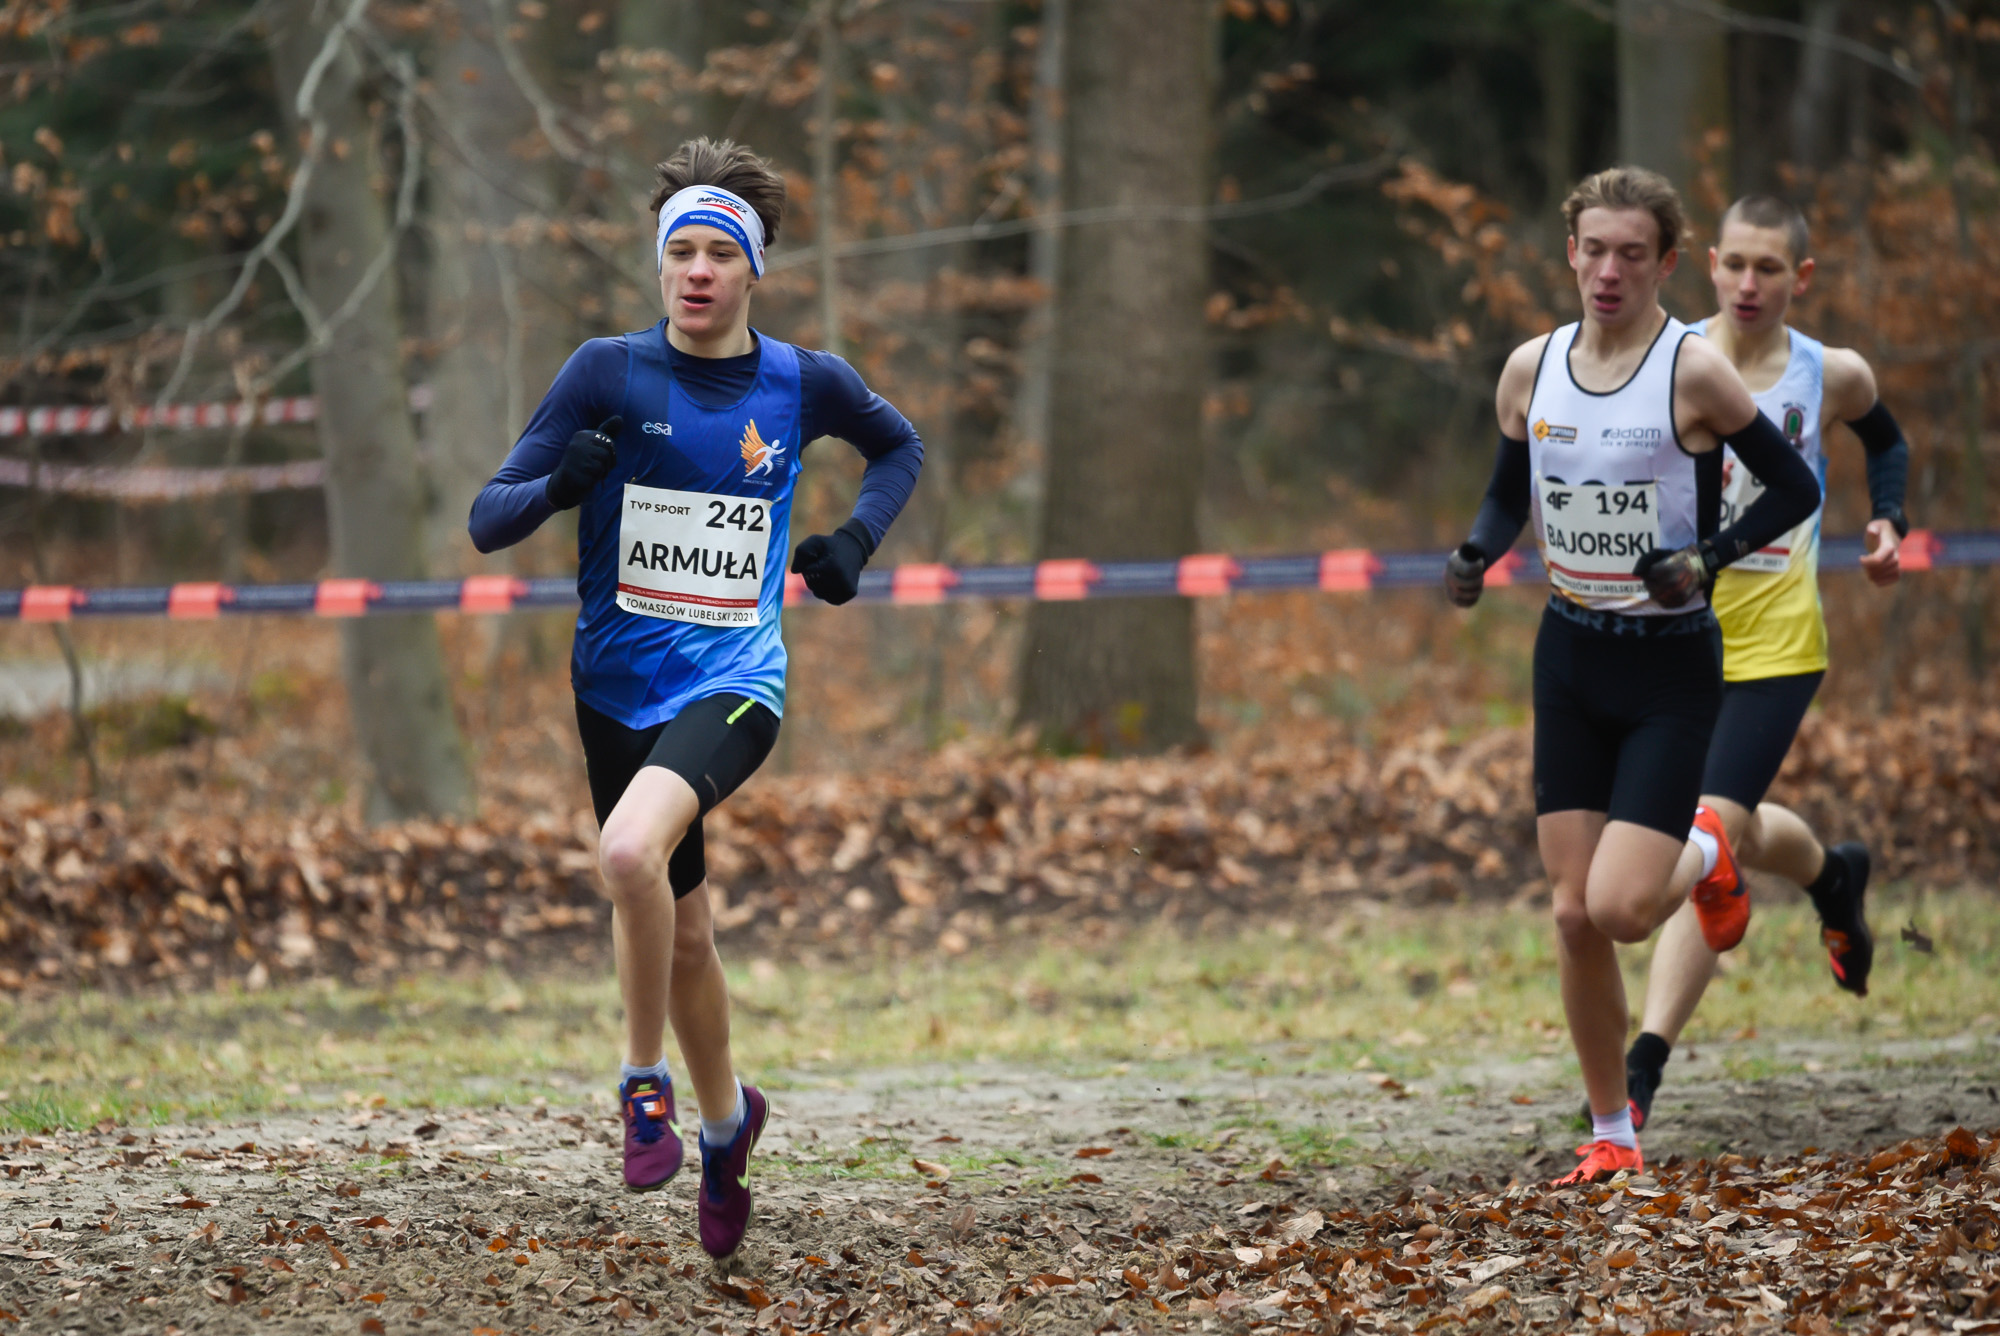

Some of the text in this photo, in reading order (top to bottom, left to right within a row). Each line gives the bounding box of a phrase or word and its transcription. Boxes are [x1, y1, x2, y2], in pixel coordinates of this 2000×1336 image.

[697, 197, 748, 215] IMPRODEX
[689, 214, 746, 241] www.improdex.pl
[642, 421, 673, 436] esa
[630, 500, 691, 516] TVP SPORT
[1595, 490, 1649, 515] 194
[706, 500, 765, 532] 242
[1546, 523, 1655, 557] BAJORSKI
[627, 540, 758, 580] ARMUŁA
[626, 597, 754, 622] TOMASZÓW LUBELSKI 2021
